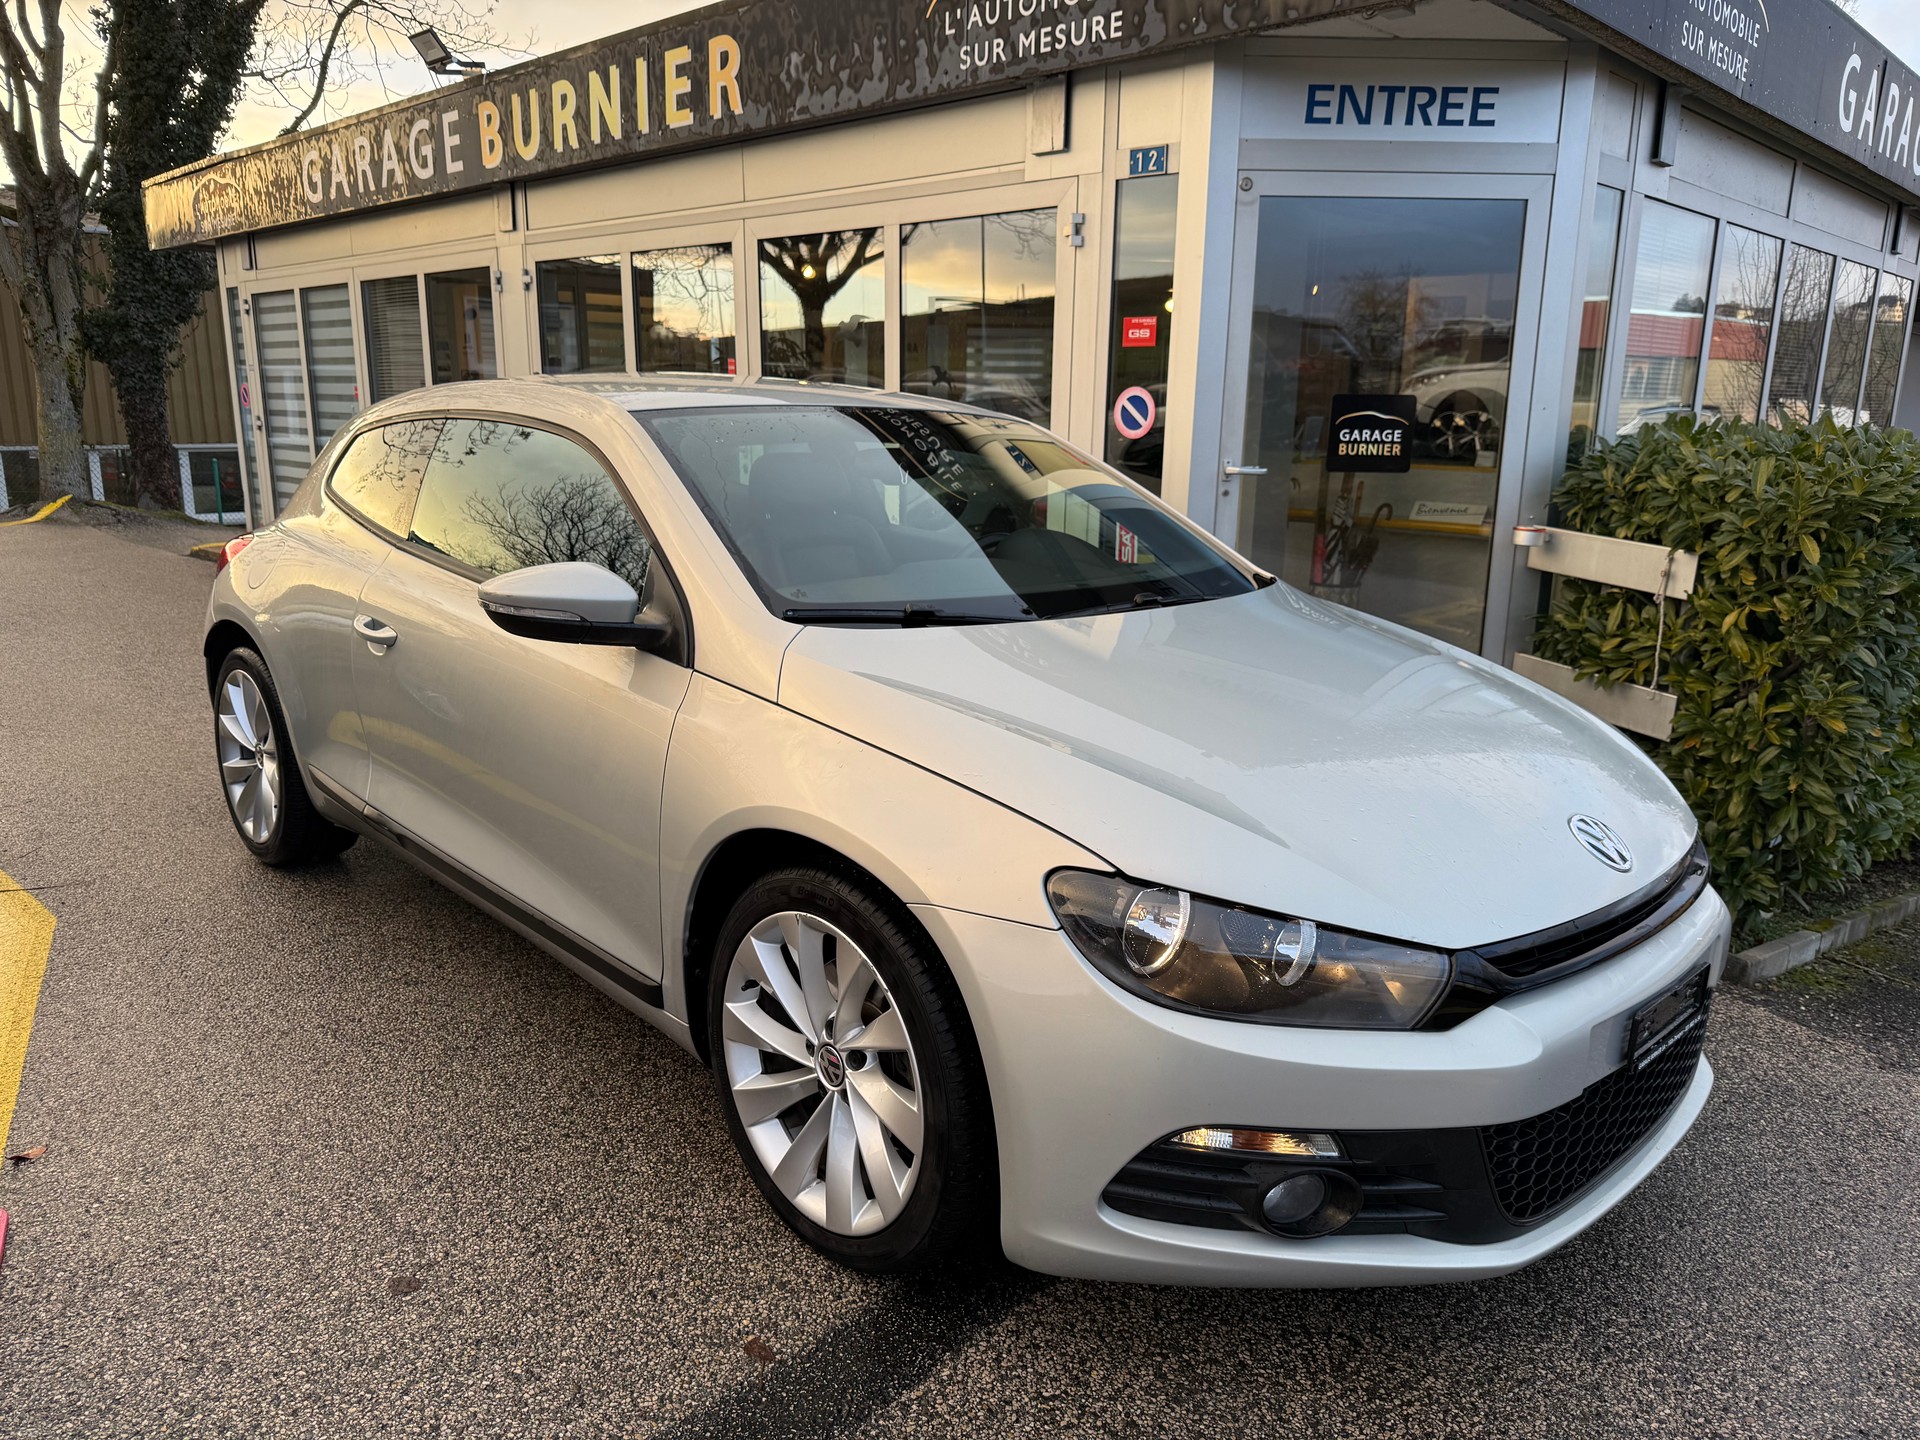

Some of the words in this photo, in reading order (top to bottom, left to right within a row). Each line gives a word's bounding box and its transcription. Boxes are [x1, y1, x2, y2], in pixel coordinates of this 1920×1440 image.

[959, 38, 1007, 70] SUR
[1018, 10, 1123, 58] MESURE
[1681, 20, 1704, 57] SUR
[1707, 36, 1749, 82] MESURE
[302, 109, 464, 203] GARAGE
[476, 34, 743, 169] BURNIER
[1304, 84, 1500, 127] ENTREE
[1136, 150, 1158, 172] 12
[1128, 328, 1150, 339] GS
[1338, 443, 1402, 456] BURNIER
[1339, 428, 1403, 442] GARAGE
